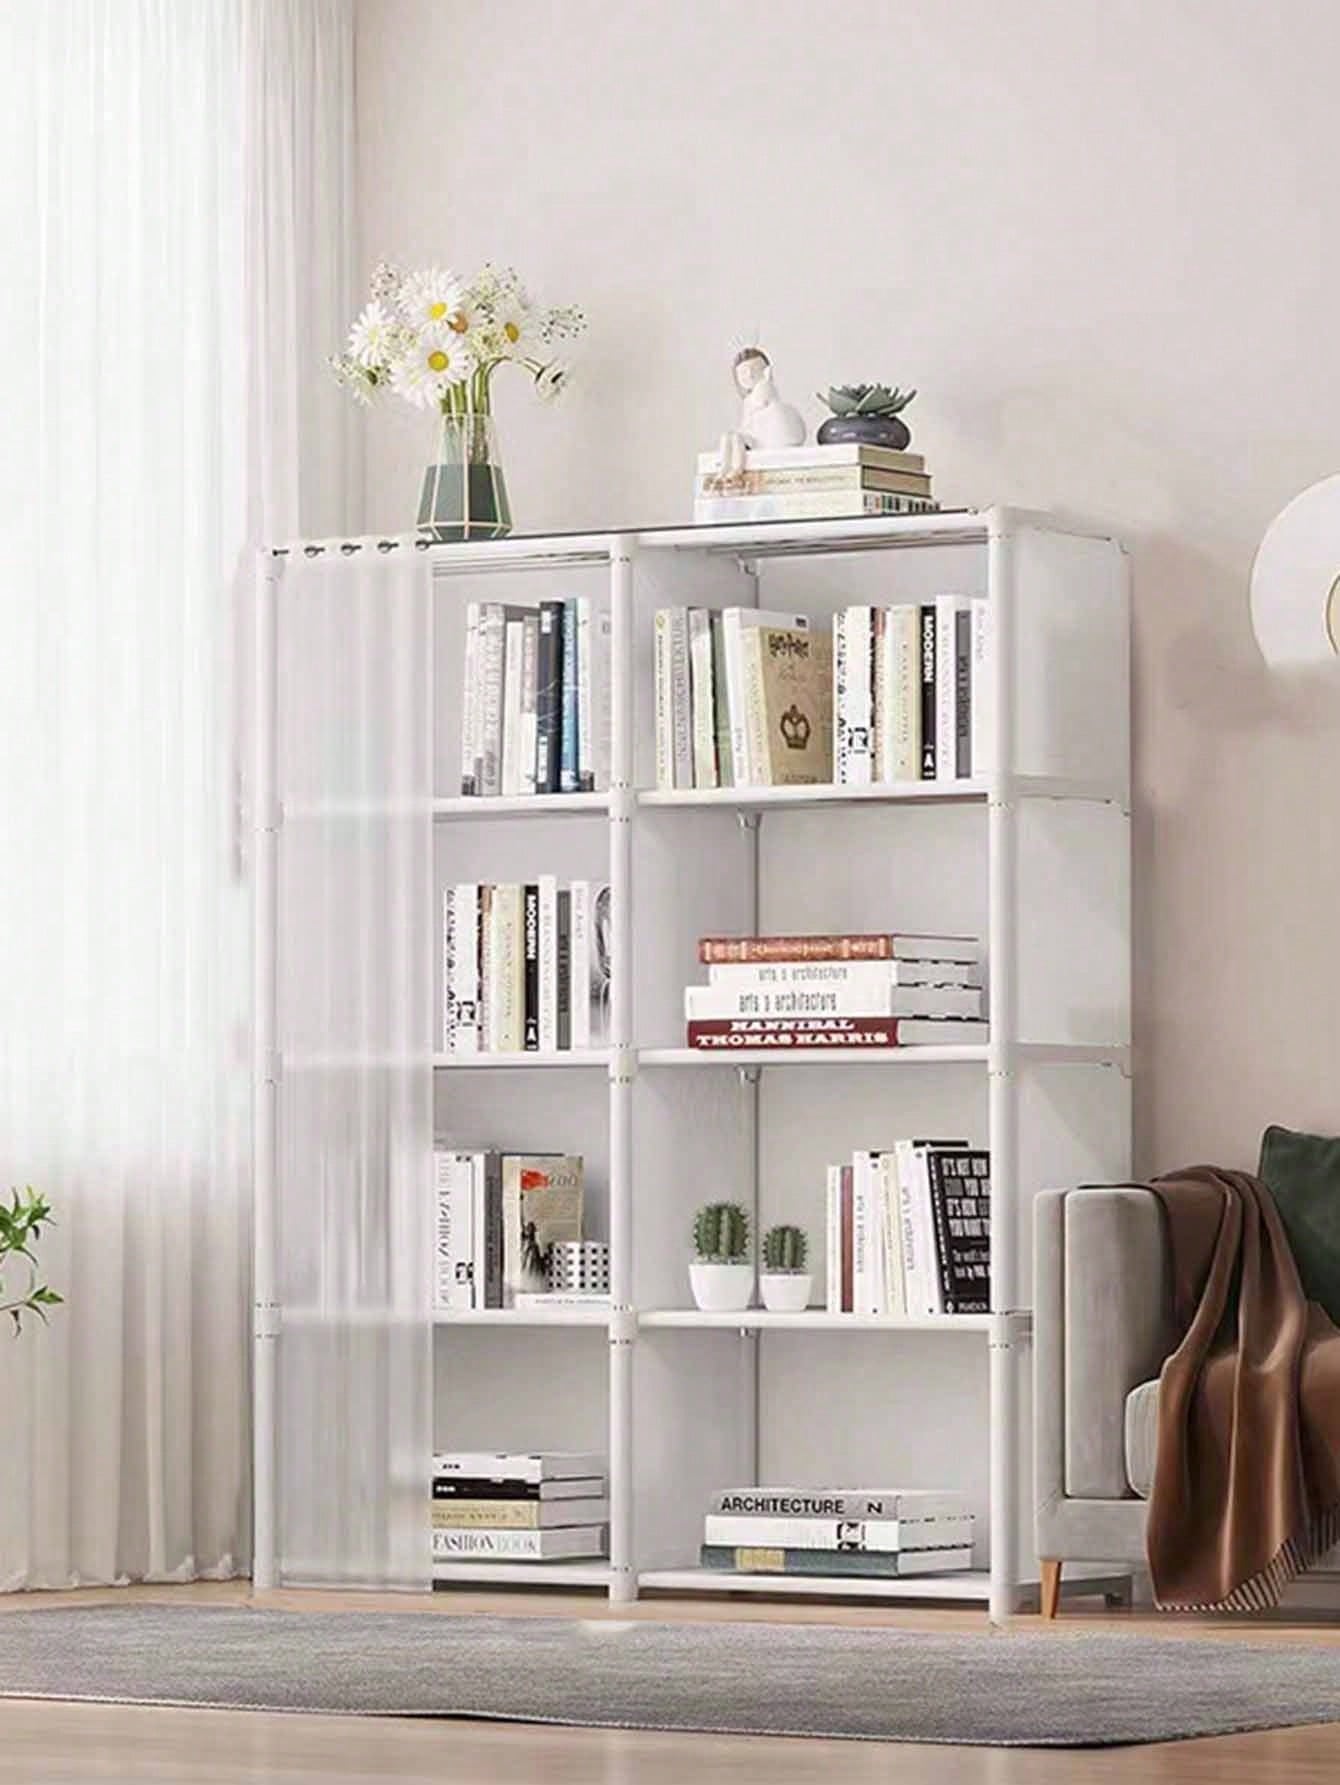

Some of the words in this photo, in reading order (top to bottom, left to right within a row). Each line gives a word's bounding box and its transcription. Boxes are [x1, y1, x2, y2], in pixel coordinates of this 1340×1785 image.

[730, 1019, 855, 1031] HANNIBAL
[697, 1033, 793, 1047] THOMAS
[796, 1032, 889, 1046] HARRIS
[721, 1496, 845, 1514] ARCHITECTURE
[433, 1533, 494, 1552] FASHION
